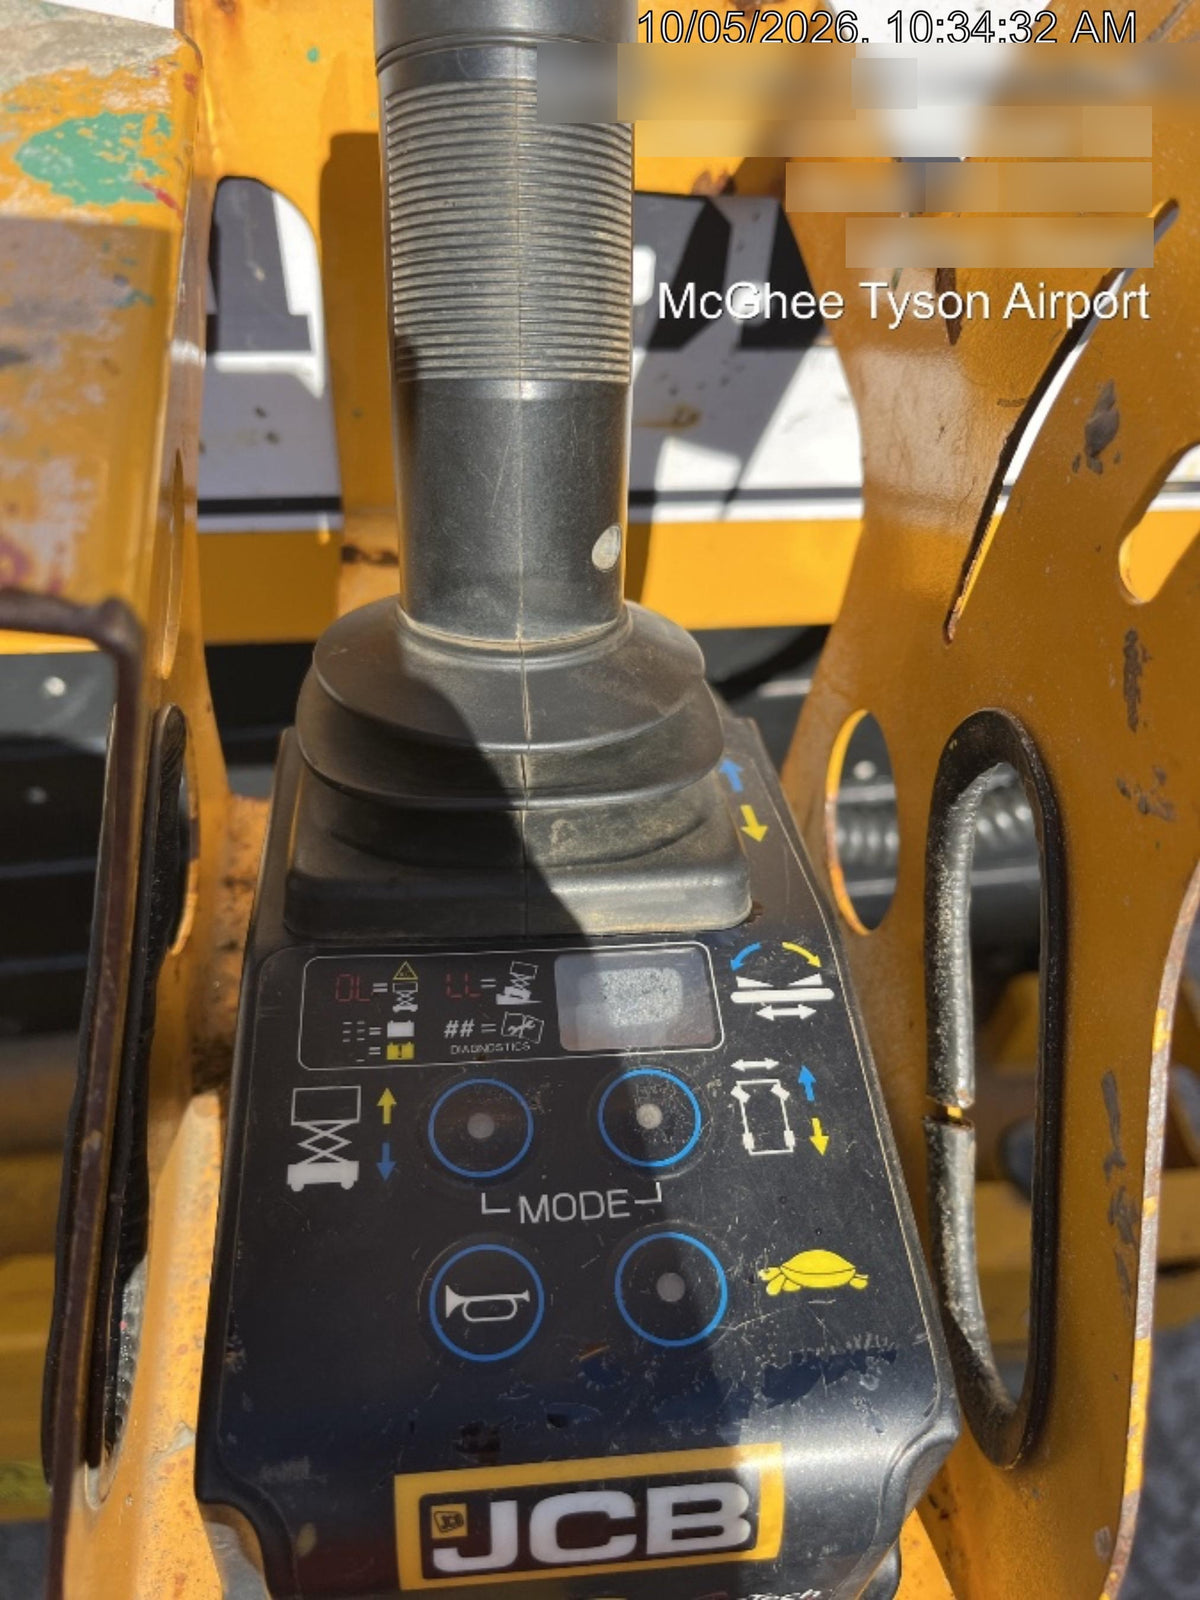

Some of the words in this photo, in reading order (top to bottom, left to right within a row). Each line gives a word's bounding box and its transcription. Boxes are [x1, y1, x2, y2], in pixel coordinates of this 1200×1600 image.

[450, 1041, 531, 1055] DIAGNOSTICS
[518, 1188, 631, 1224] MODE
[432, 1482, 752, 1572] JCB
